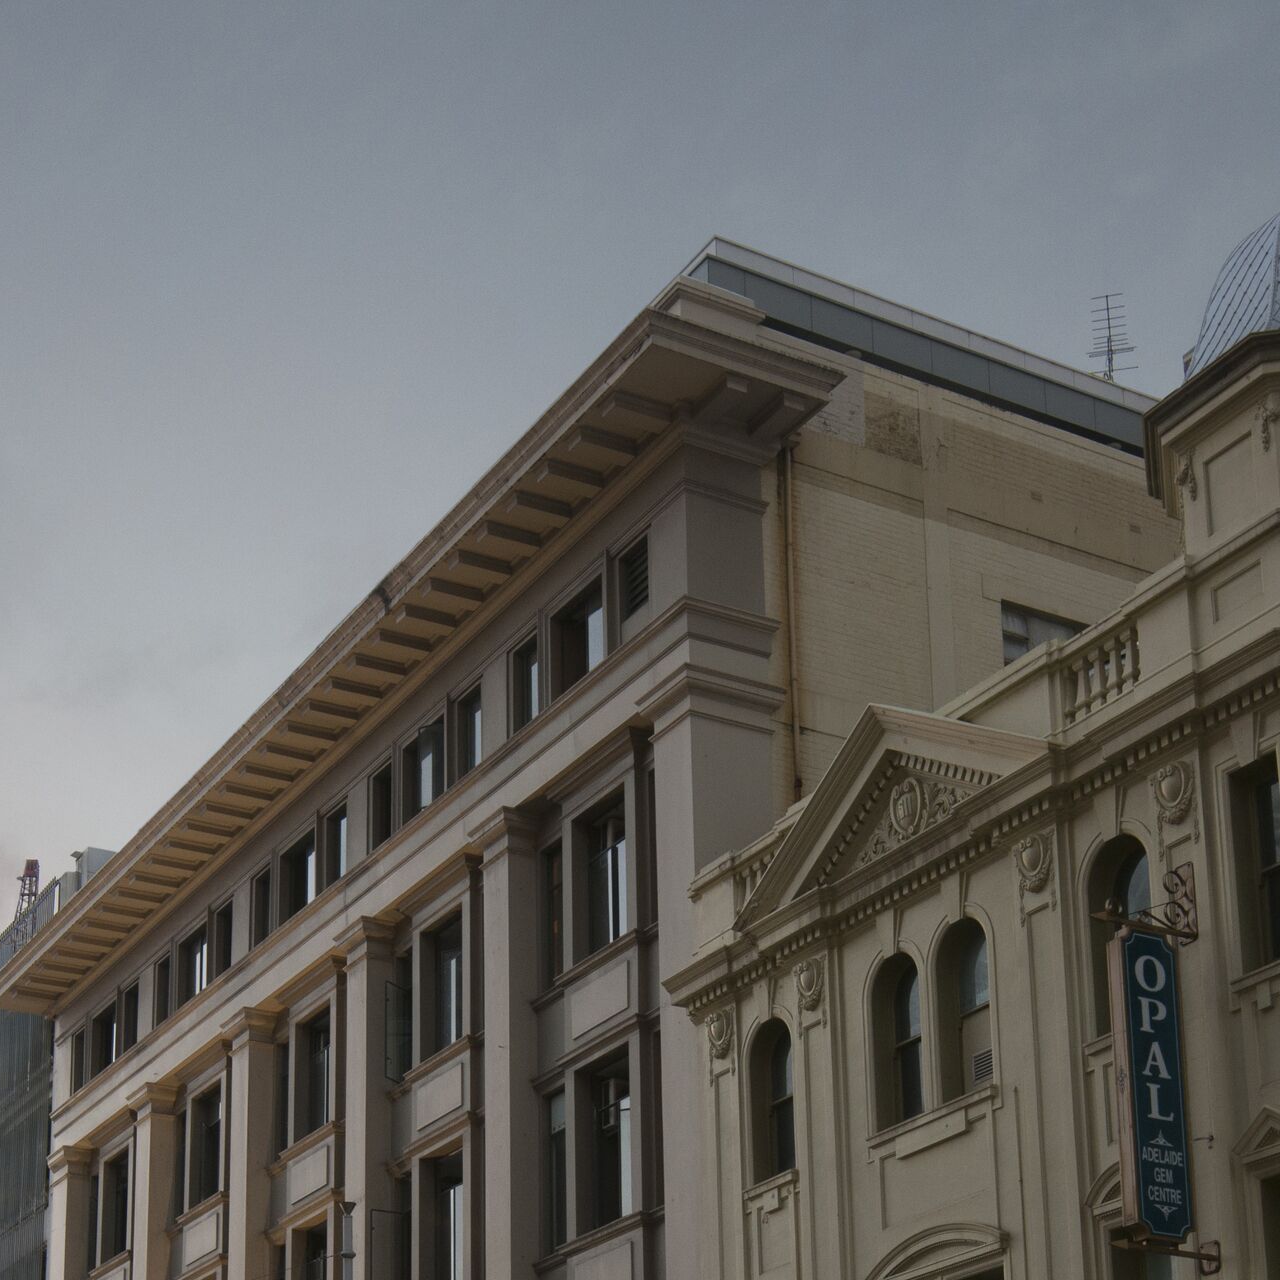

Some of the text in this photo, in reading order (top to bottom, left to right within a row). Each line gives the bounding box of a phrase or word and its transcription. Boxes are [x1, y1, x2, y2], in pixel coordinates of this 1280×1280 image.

[1134, 955, 1174, 1122] OPAL
[1142, 1146, 1184, 1167] ADELAIDE
[1154, 1167, 1173, 1184] GEM
[1148, 1184, 1182, 1205] CENTRE
